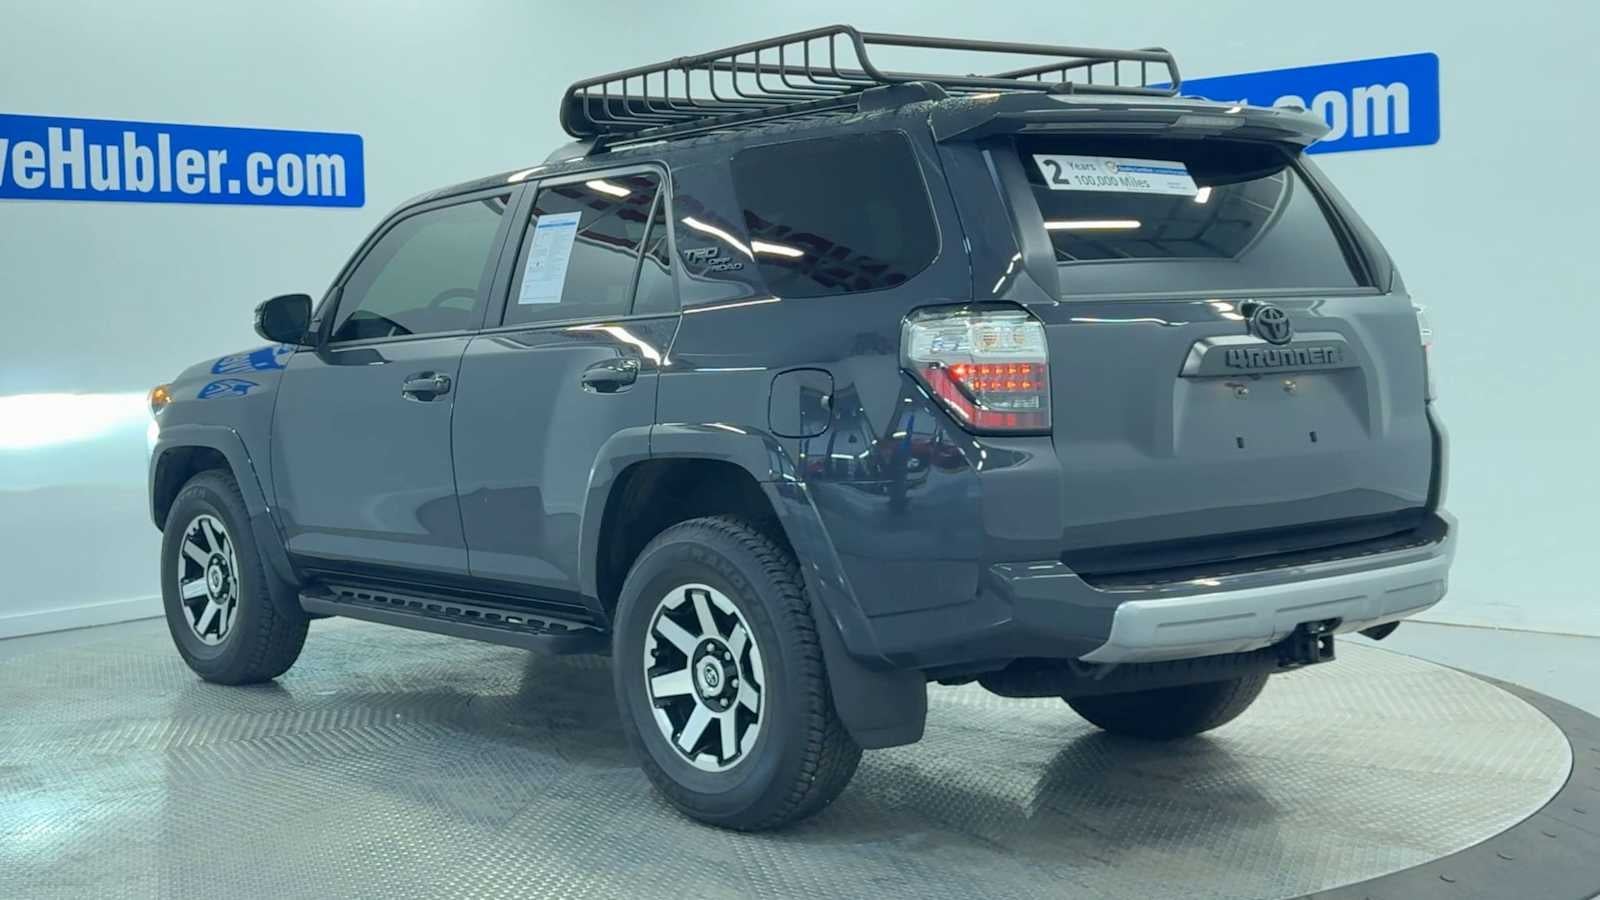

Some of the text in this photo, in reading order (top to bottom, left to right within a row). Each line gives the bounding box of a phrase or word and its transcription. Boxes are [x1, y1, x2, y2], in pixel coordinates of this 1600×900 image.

[1043, 159, 1070, 185] 2
[1068, 161, 1096, 171] Years
[1075, 175, 1150, 188] 100,000 Miles
[684, 247, 718, 264] TRD
